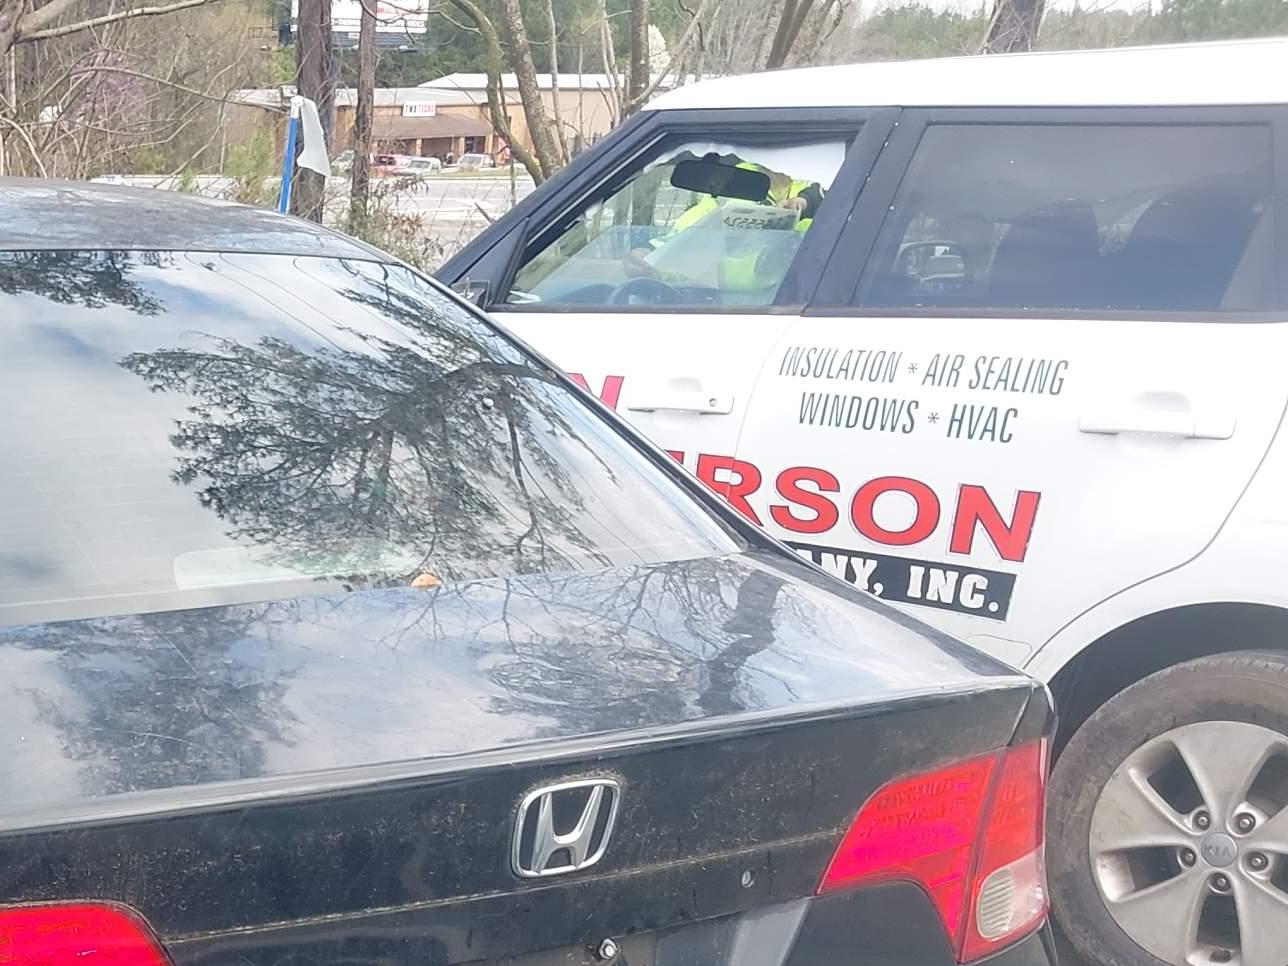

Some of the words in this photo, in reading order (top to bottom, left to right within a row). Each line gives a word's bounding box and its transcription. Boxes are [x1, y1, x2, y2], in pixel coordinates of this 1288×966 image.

[778, 346, 903, 384] INSULATION
[921, 353, 965, 388] AIR
[968, 355, 1069, 396] SEALING
[799, 391, 920, 435] WINDOWS
[946, 403, 1019, 444] HVAC
[664, 449, 1042, 563] RSON
[906, 564, 1000, 613] INC.
